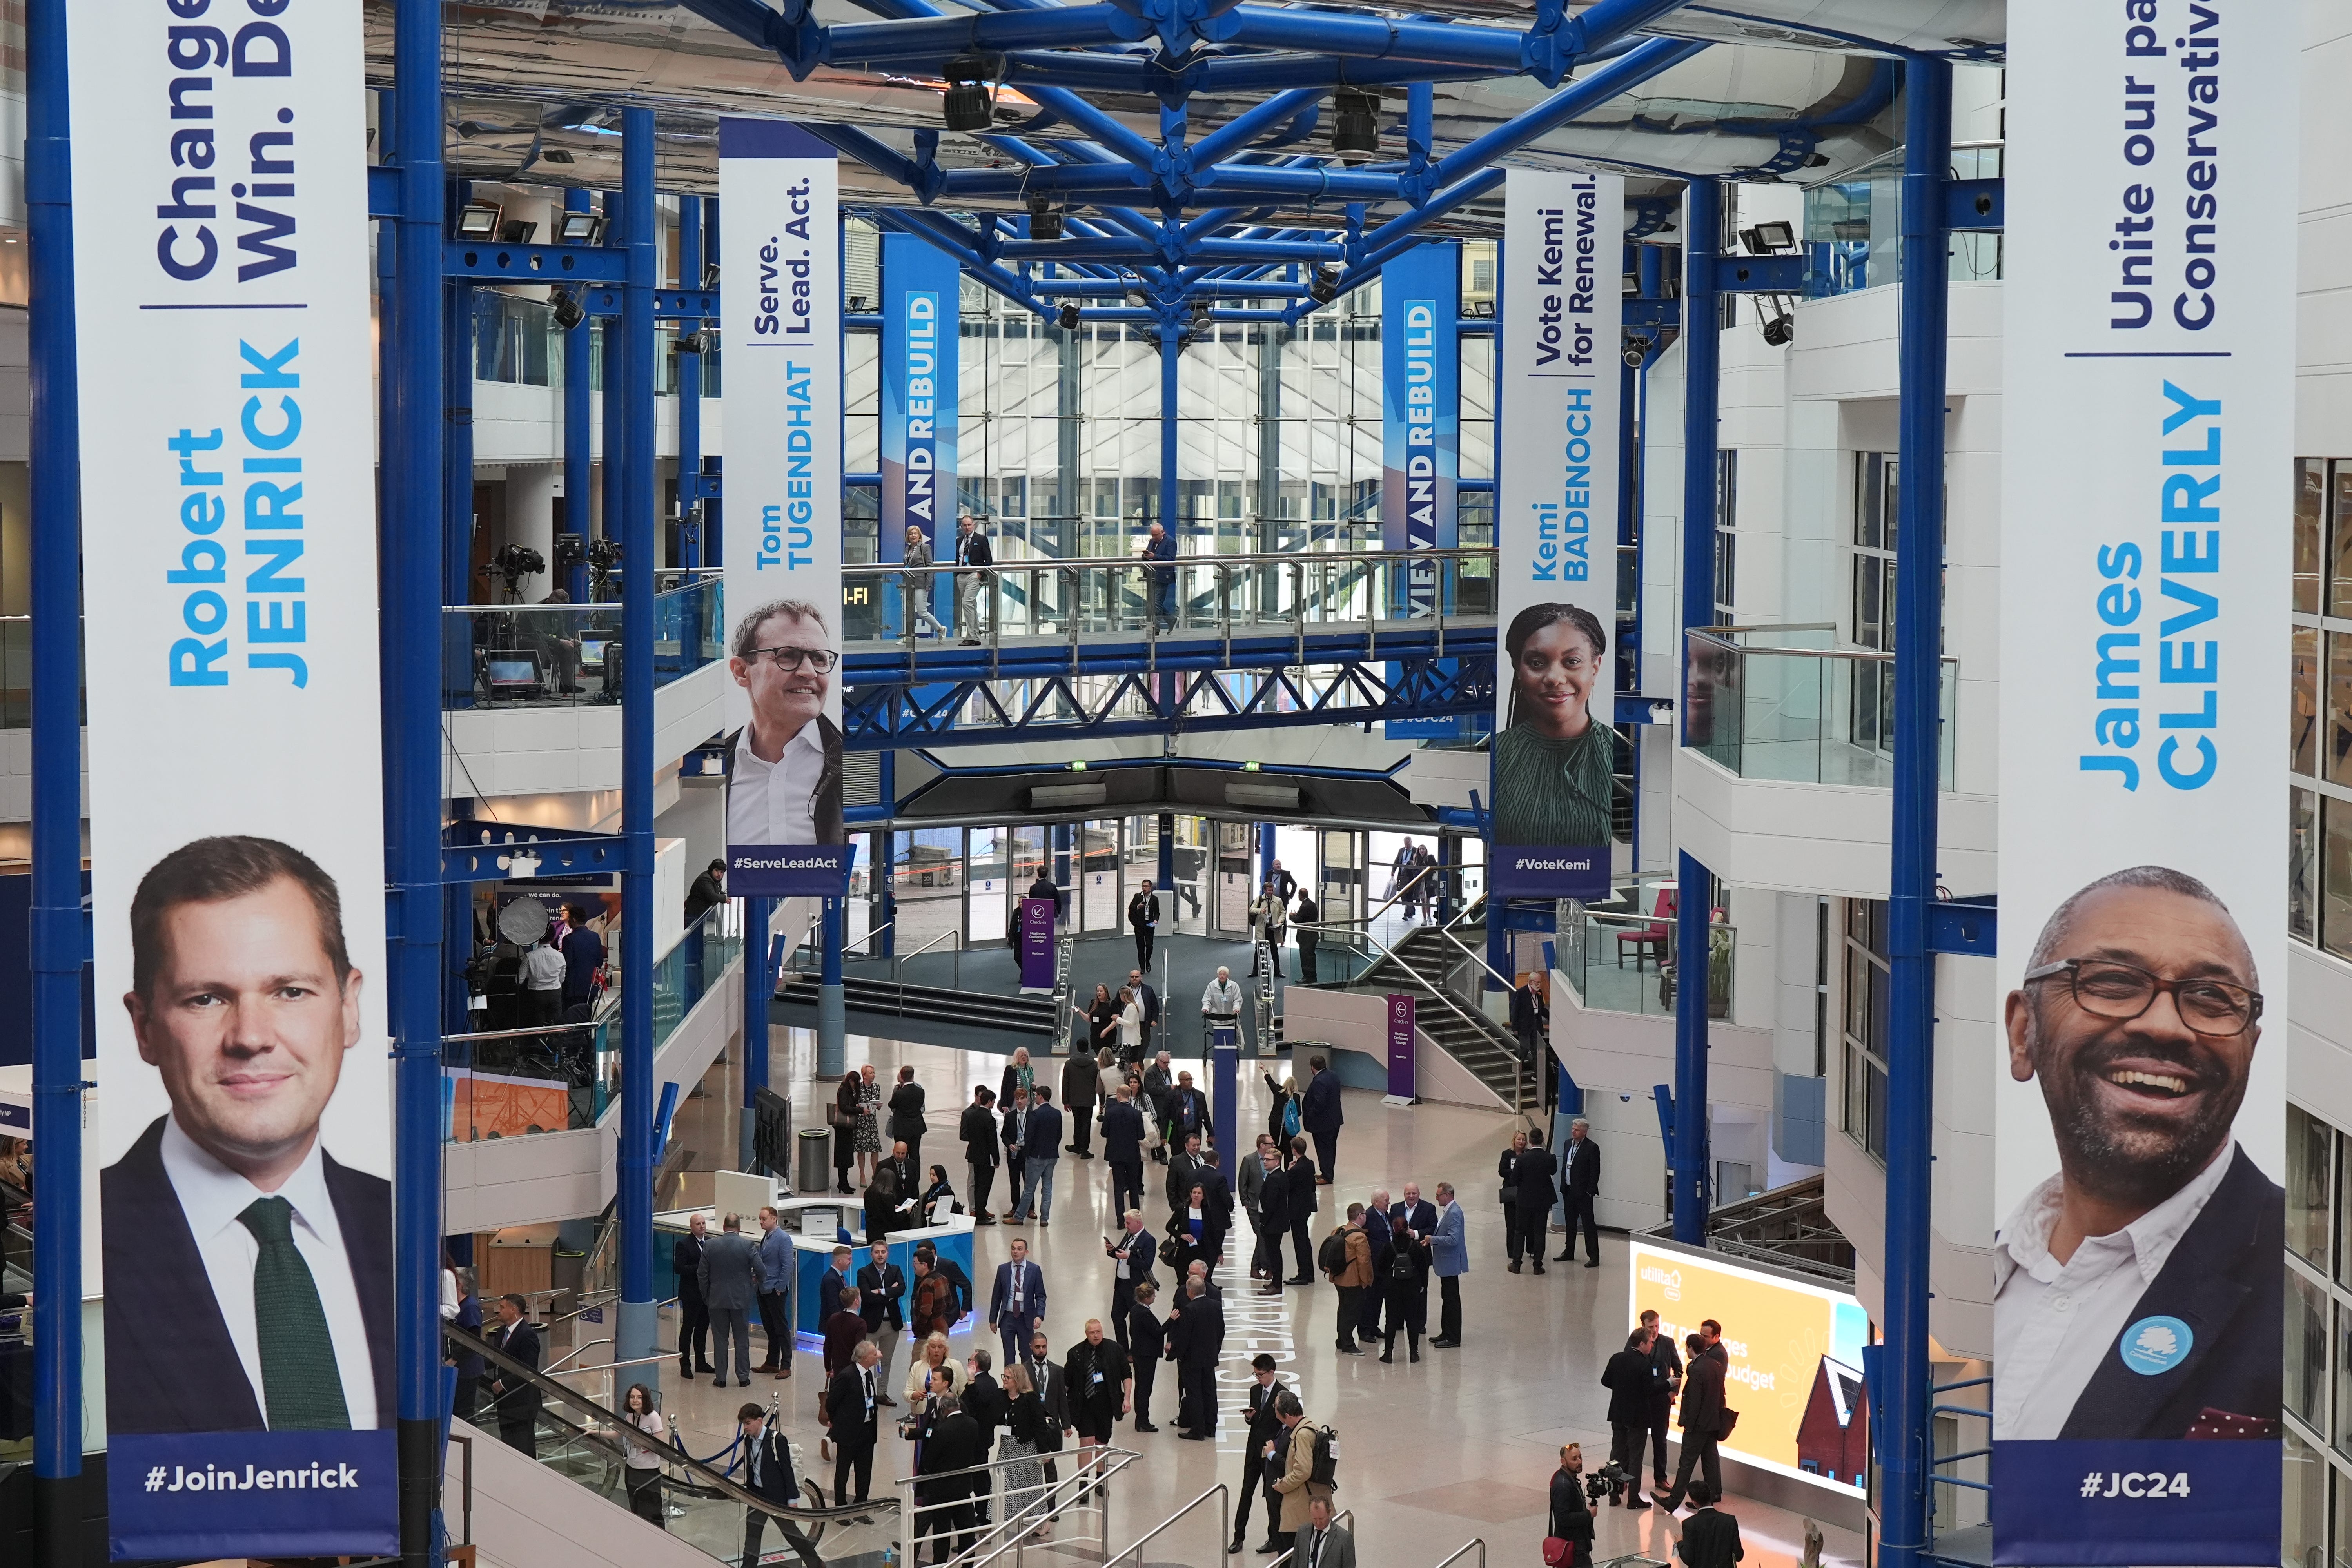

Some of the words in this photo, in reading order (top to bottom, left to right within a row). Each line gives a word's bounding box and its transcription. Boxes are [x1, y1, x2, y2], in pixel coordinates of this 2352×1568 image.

[2124, 76, 2155, 166] our
[231, 108, 296, 283] Win.
[2174, 0, 2219, 330] Conservativ
[786, 178, 809, 240] Act.
[1537, 209, 1563, 285] Kemi
[1569, 174, 1595, 313] Renewal.
[755, 237, 779, 334] Serve.
[786, 250, 810, 333] Lead.
[2109, 184, 2154, 328] Unite
[909, 297, 934, 438] REBUILD
[1536, 295, 1561, 366] Vote
[1568, 323, 1592, 366] for
[1408, 306, 1433, 446] REBUILD
[787, 361, 812, 570] TUGENDHAT
[908, 448, 933, 519] AND
[1408, 455, 1433, 527] AND
[1564, 389, 1591, 581] BADENOCH
[240, 338, 308, 689] JENRICK
[757, 506, 780, 570] Tom
[1532, 504, 1557, 580] Kemi
[167, 428, 228, 686] Robert
[1409, 534, 1434, 618] VIEW
[2158, 380, 2221, 790] CLEVERLY
[844, 587, 867, 605] I-FI
[2080, 542, 2142, 792] James
[902, 708, 949, 718] #C24
[734, 858, 837, 868] #ServeLeadAct
[1516, 859, 1590, 870] #VoteKemi
[1641, 1265, 1671, 1285] utilita
[1658, 1315, 1676, 1336] lar
[2129, 1350, 2167, 1365] Conservatives
[145, 1462, 358, 1491] #JoinJenrick
[2081, 1473, 2190, 1497] #JC24
